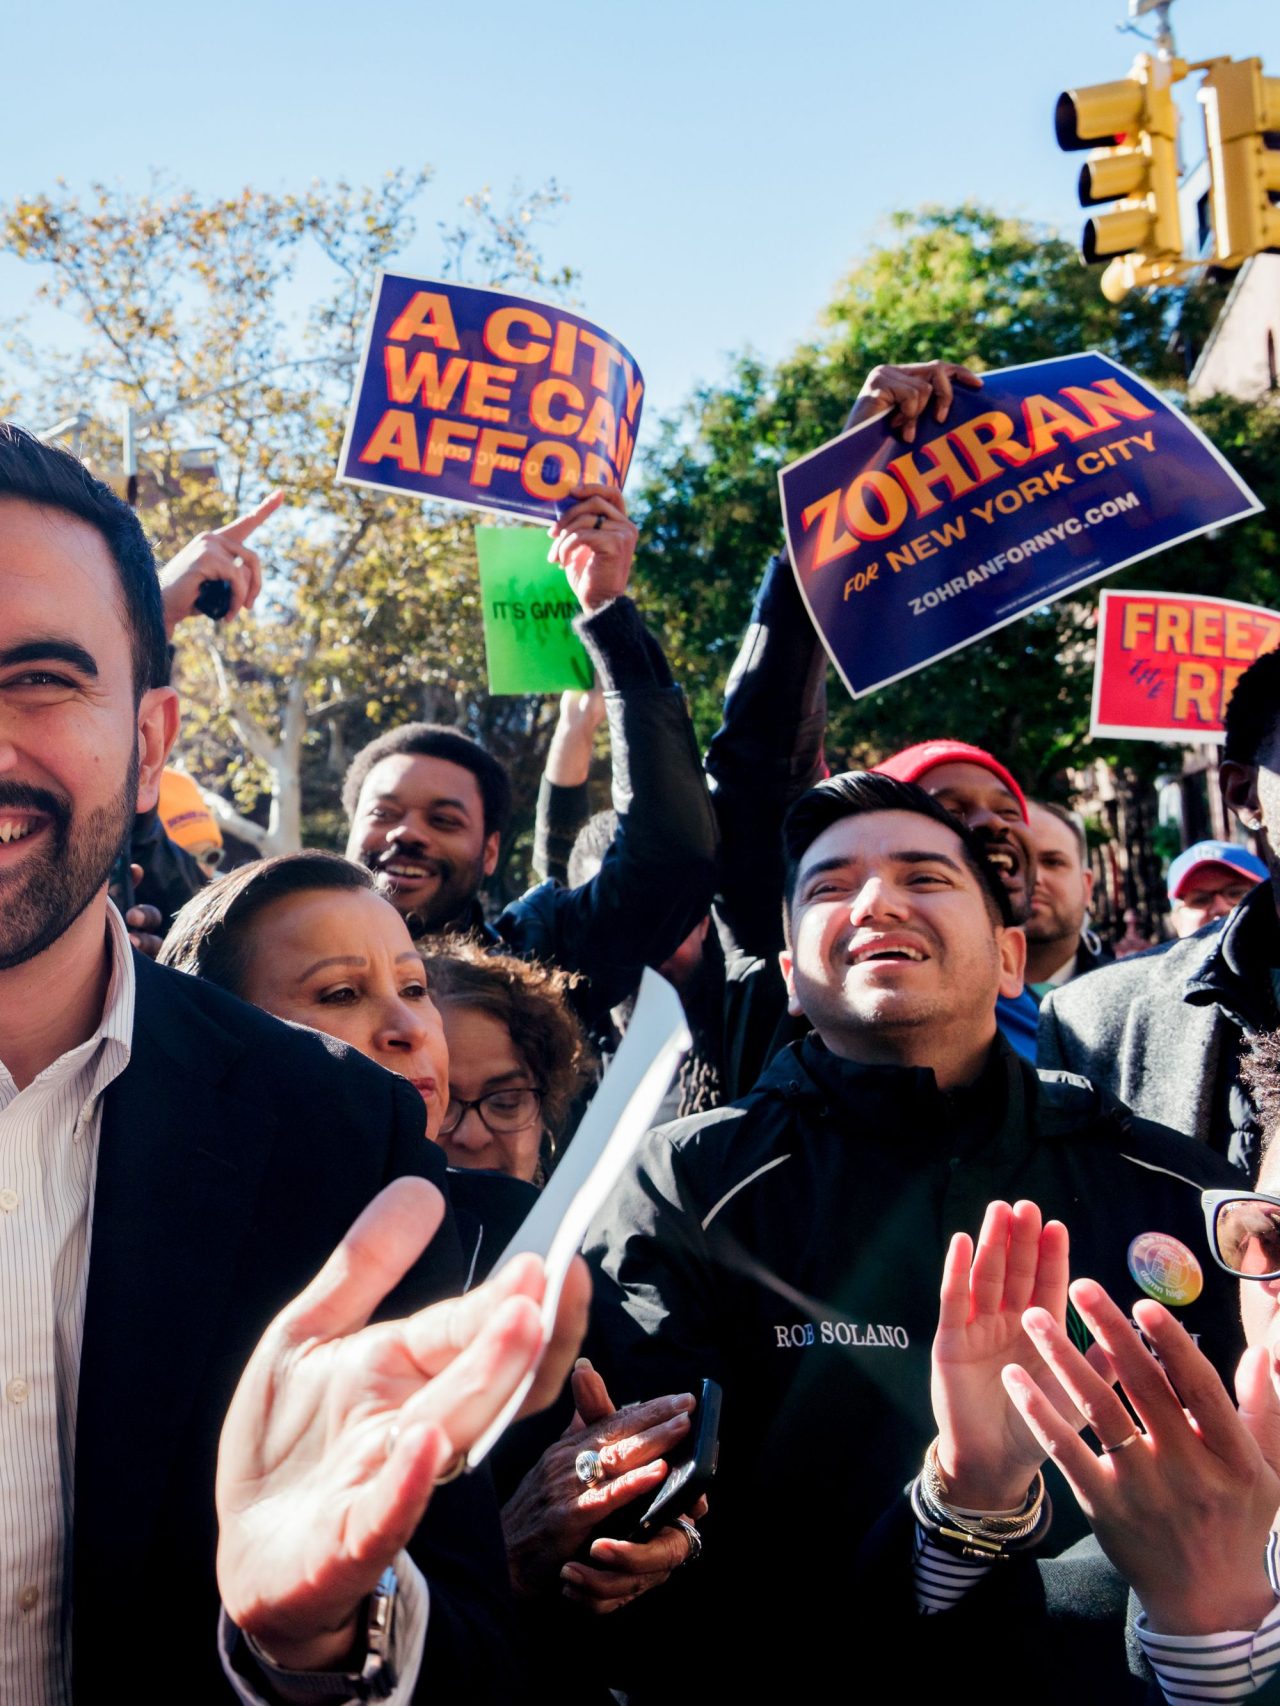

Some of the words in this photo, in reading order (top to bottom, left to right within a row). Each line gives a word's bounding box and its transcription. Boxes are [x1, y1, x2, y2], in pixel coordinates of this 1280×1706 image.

[384, 344, 517, 423] WE
[387, 290, 461, 351] A
[483, 306, 644, 425] CITY
[358, 408, 619, 501] AFFOR
[800, 377, 1156, 572] ZOHRAN
[843, 561, 880, 602] FOR
[885, 516, 968, 573] NEW
[970, 463, 1075, 525] YORK
[1075, 430, 1157, 477] CITY
[907, 491, 1141, 616] ZOHRANFORNYC.COM
[1128, 658, 1165, 699] THE
[1140, 1269, 1164, 1294] damn
[774, 1323, 815, 1348] ROB
[820, 1320, 910, 1349] SOLANO
